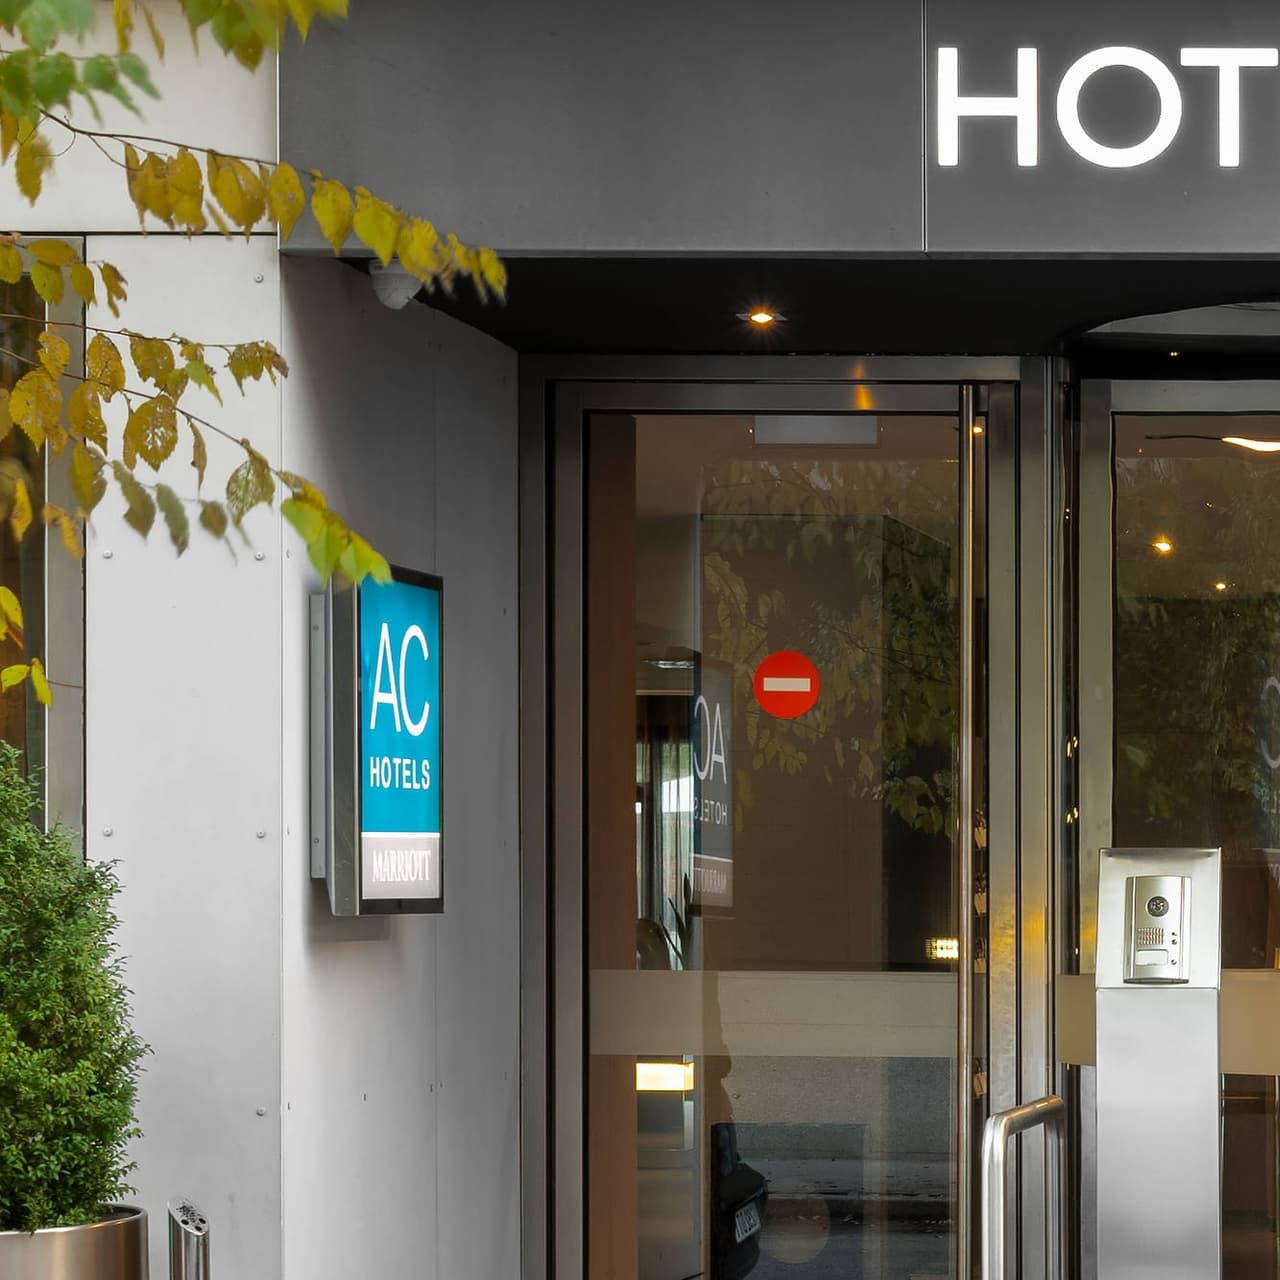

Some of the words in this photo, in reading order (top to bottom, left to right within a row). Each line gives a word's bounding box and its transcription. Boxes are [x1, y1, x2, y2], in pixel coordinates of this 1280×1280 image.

[370, 622, 430, 737] AC
[370, 756, 431, 791] HOTELS
[372, 849, 432, 883] MARRIOTT
